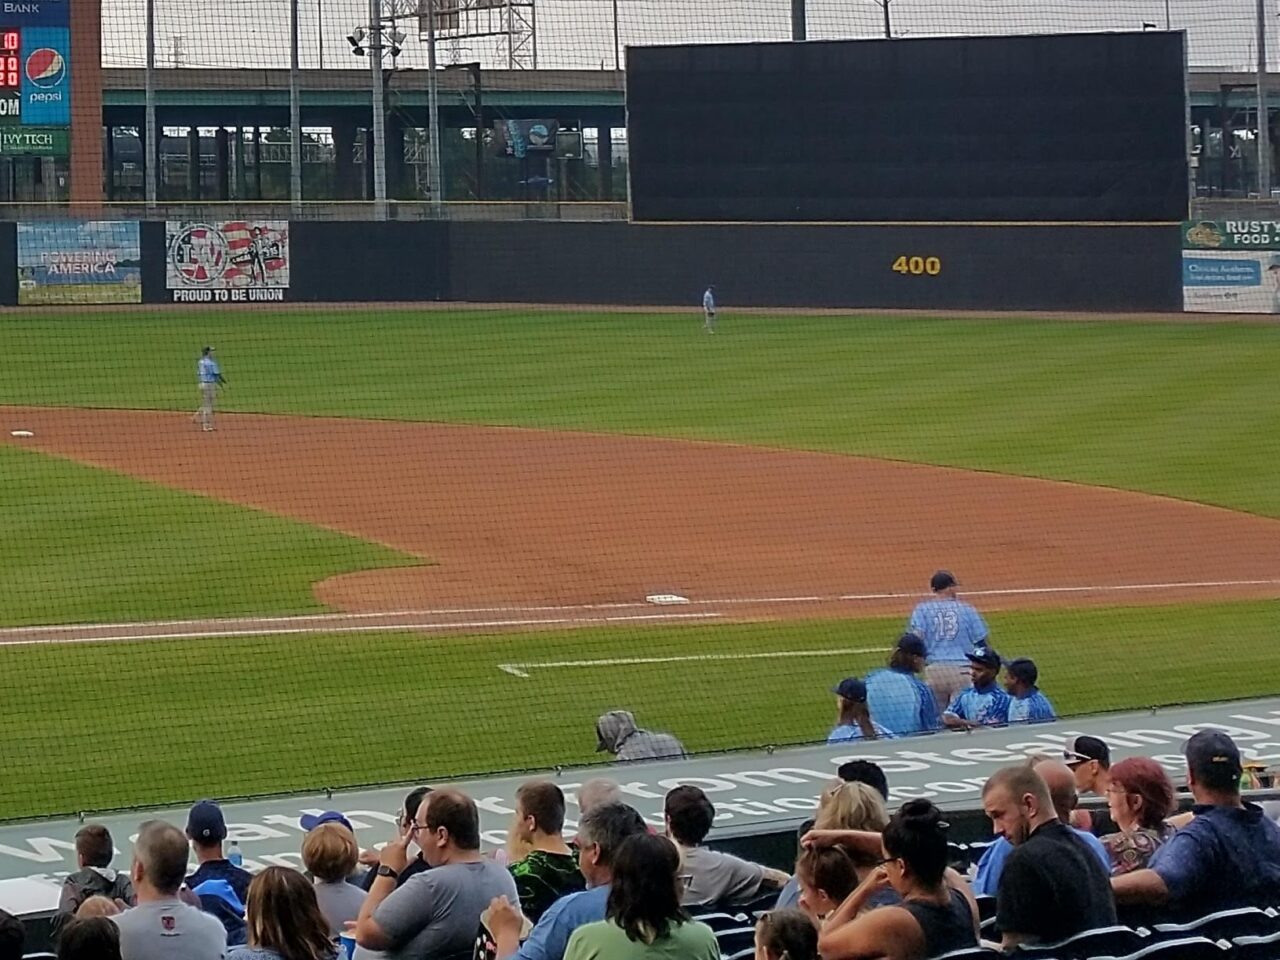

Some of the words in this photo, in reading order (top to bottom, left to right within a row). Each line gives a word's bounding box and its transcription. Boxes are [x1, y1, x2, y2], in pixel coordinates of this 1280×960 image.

[4, 3, 40, 13] BANK
[29, 90, 62, 103] pepsi
[4, 134, 20, 144] IVY
[22, 134, 52, 144] TECH
[1234, 234, 1270, 244] FOOD
[41, 251, 116, 263] POWERING
[48, 262, 116, 274] AMERICA
[892, 255, 942, 276] 400
[174, 290, 212, 302] PROUD
[214, 290, 228, 301] TO
[232, 290, 247, 300] BE
[249, 289, 283, 300] UNION
[934, 610, 960, 640] 13
